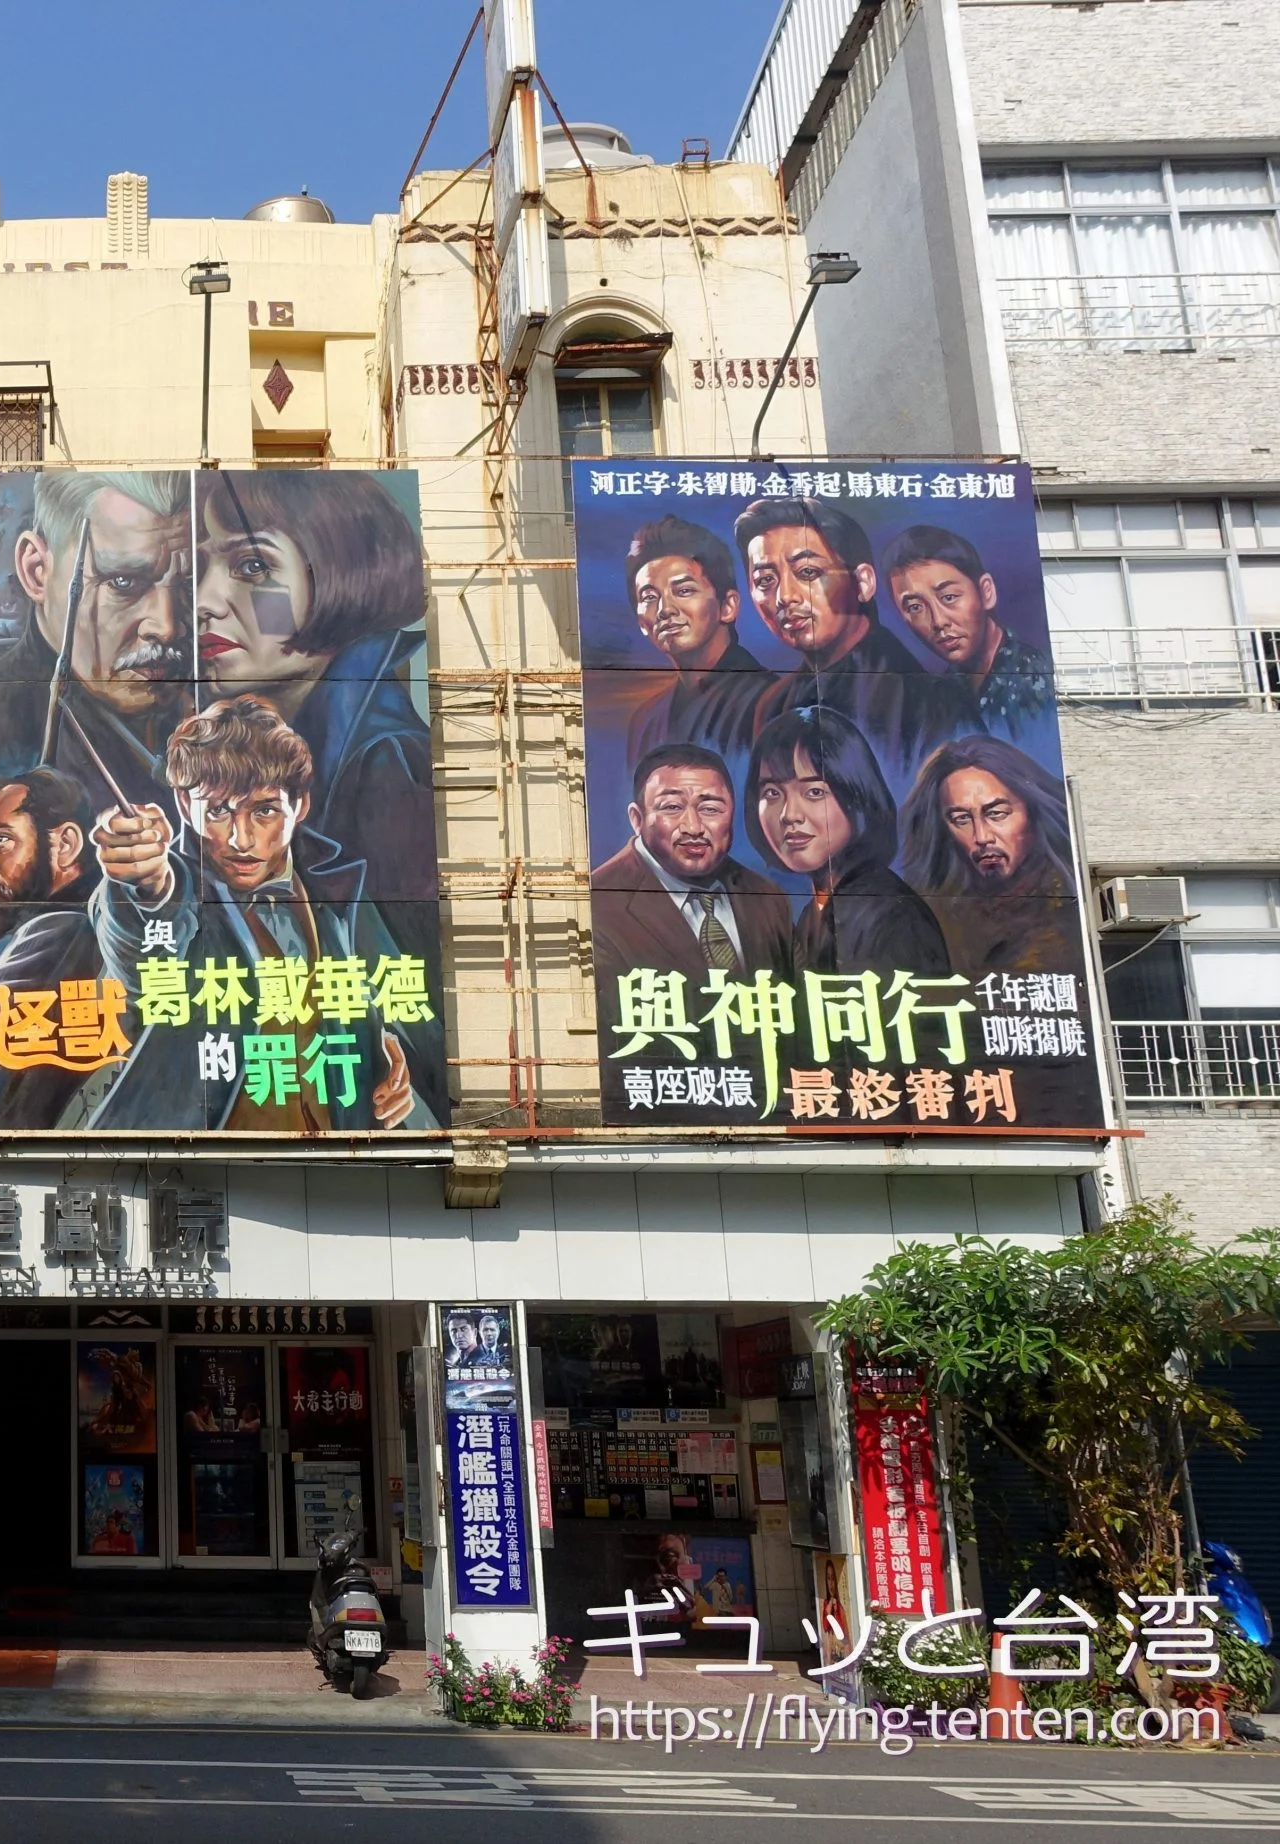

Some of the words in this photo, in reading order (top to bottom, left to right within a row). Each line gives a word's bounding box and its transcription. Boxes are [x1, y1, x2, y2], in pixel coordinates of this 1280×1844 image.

[141, 918, 177, 955] 與
[134, 953, 435, 1027] 葛林戴華德
[974, 972, 1078, 1012] 千年謎團
[606, 966, 977, 1120] 與神同行
[622, 1066, 757, 1111] 賣座破億
[783, 1068, 1017, 1122] 最終審判
[70, 1266, 216, 1284] THEATER
[456, 1414, 504, 1597] 潛艦獵殺令
